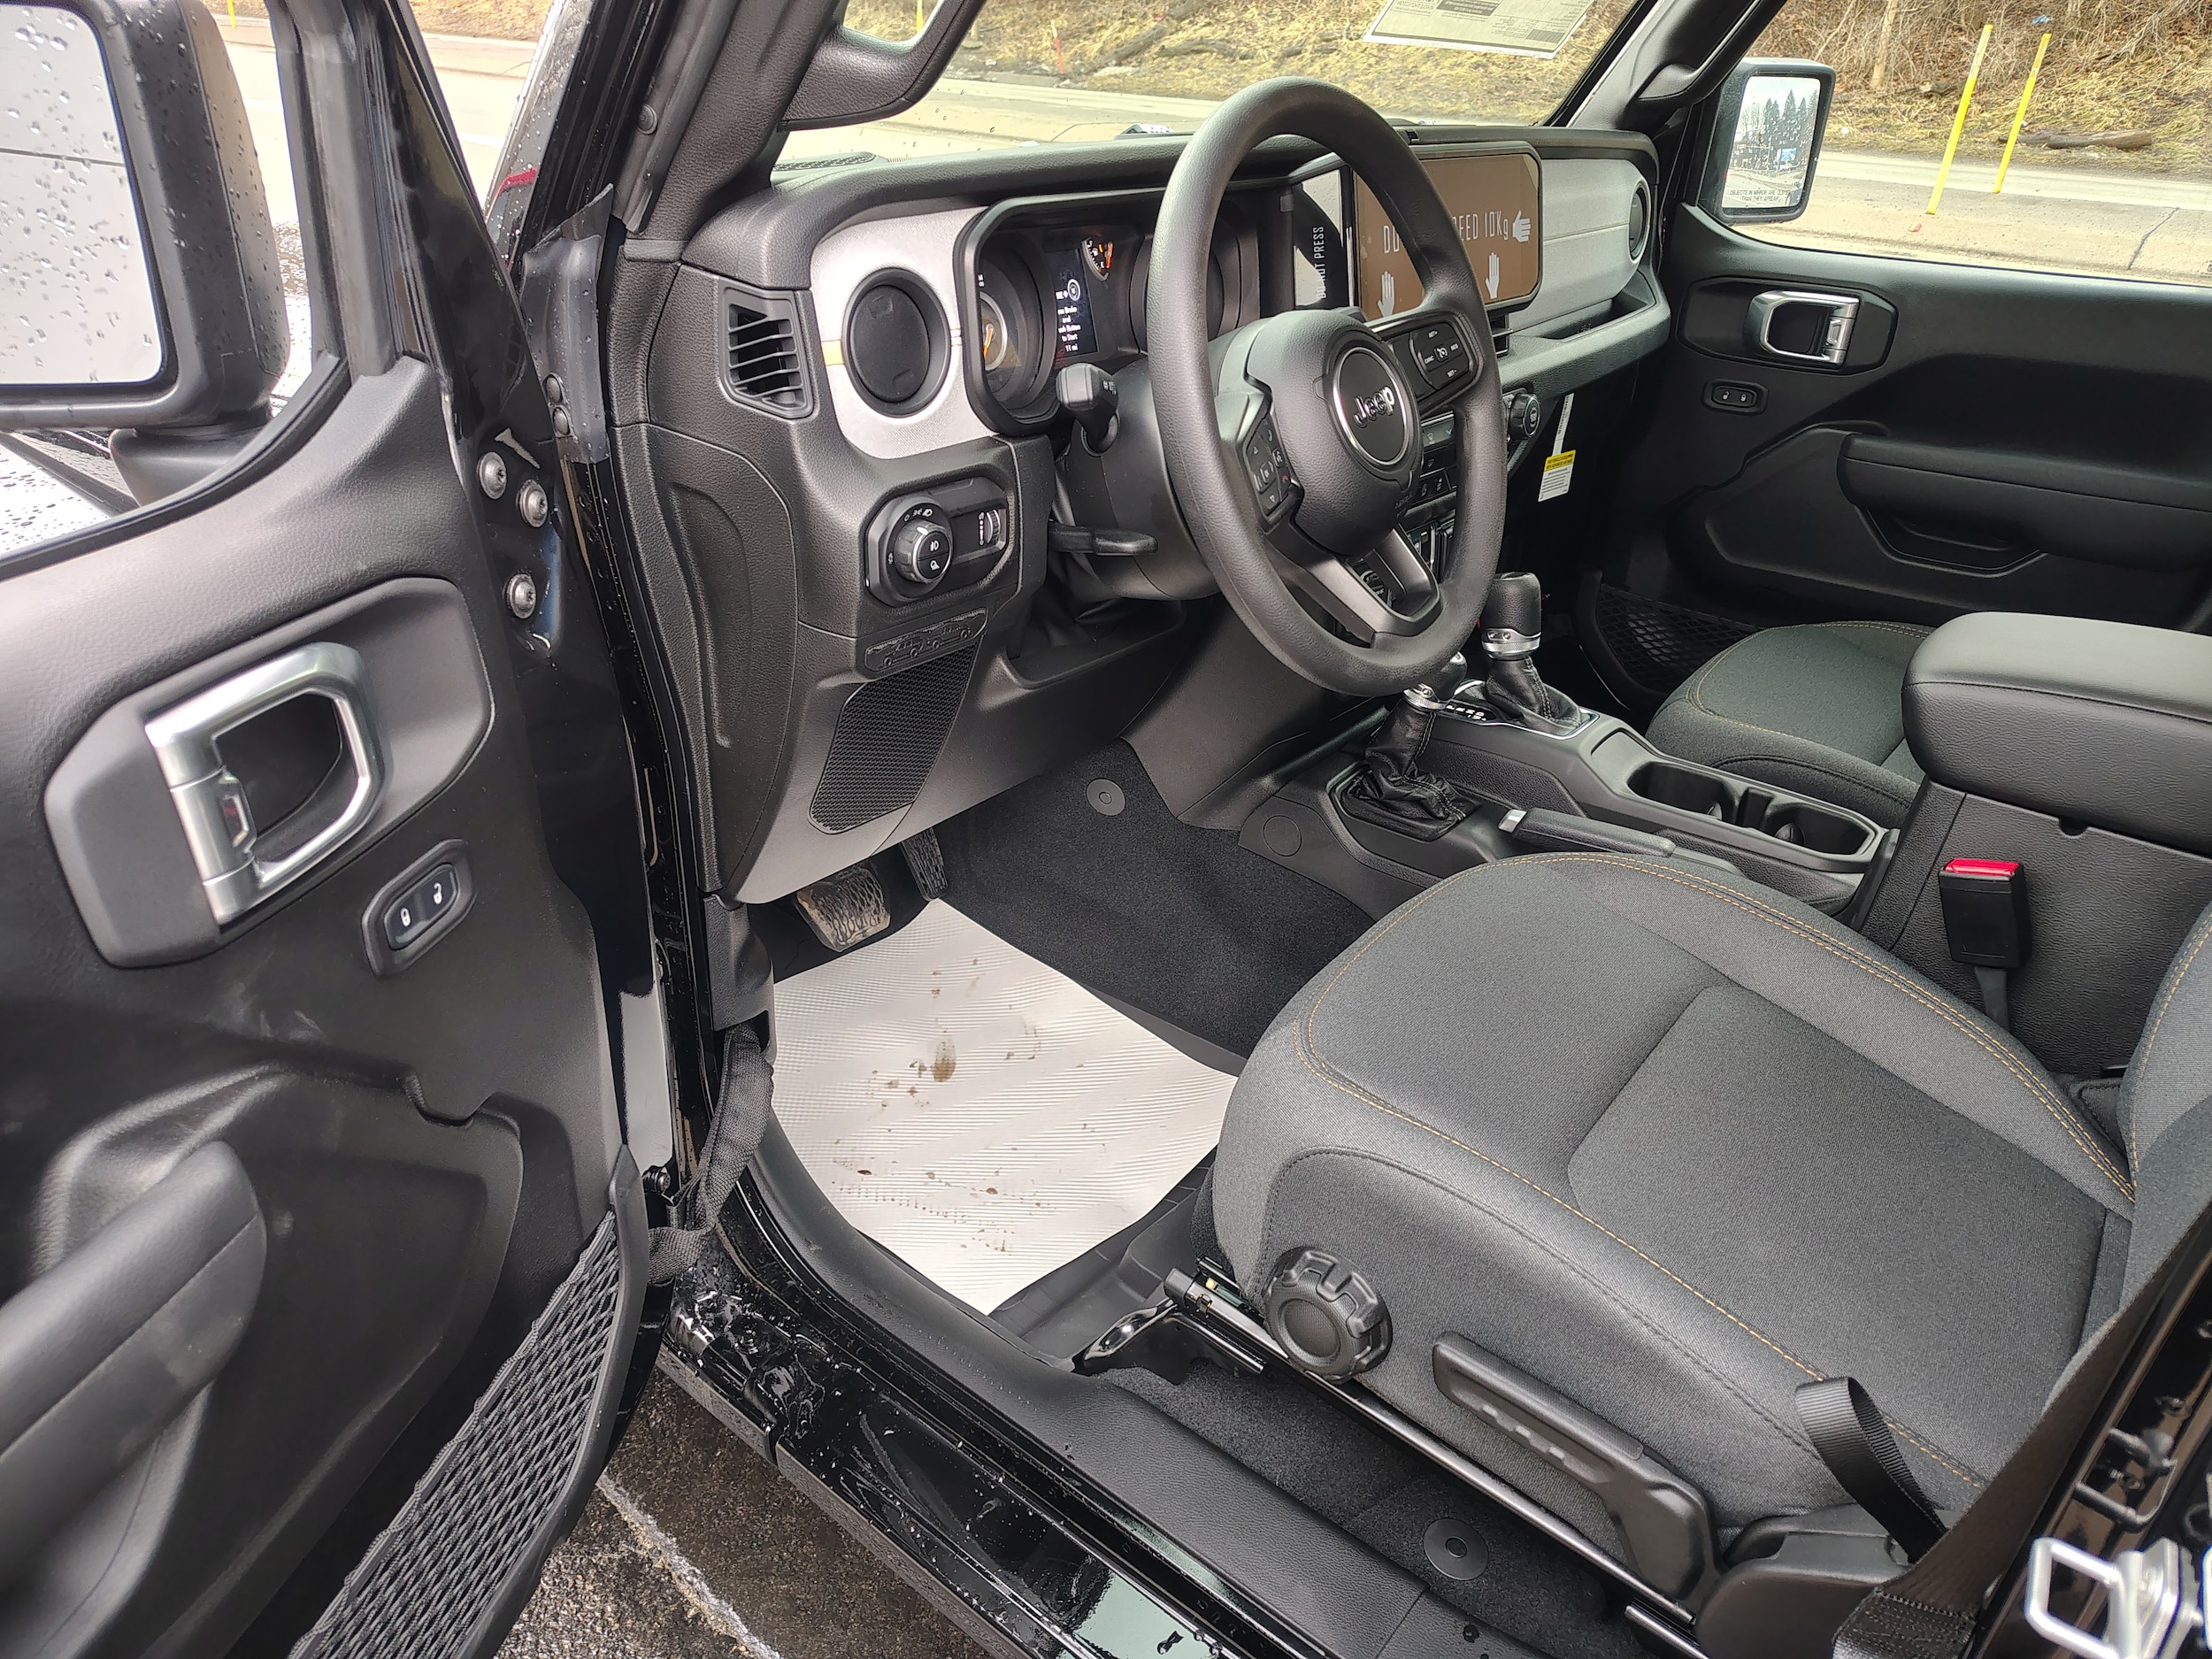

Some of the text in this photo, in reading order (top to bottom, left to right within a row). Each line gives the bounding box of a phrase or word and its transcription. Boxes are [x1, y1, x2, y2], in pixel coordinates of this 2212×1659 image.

[1452, 213, 1479, 241] EED
[1484, 210, 1509, 241] 10Kg
[1312, 227, 1325, 259] PRESS
[1353, 386, 1395, 428] Jeep
